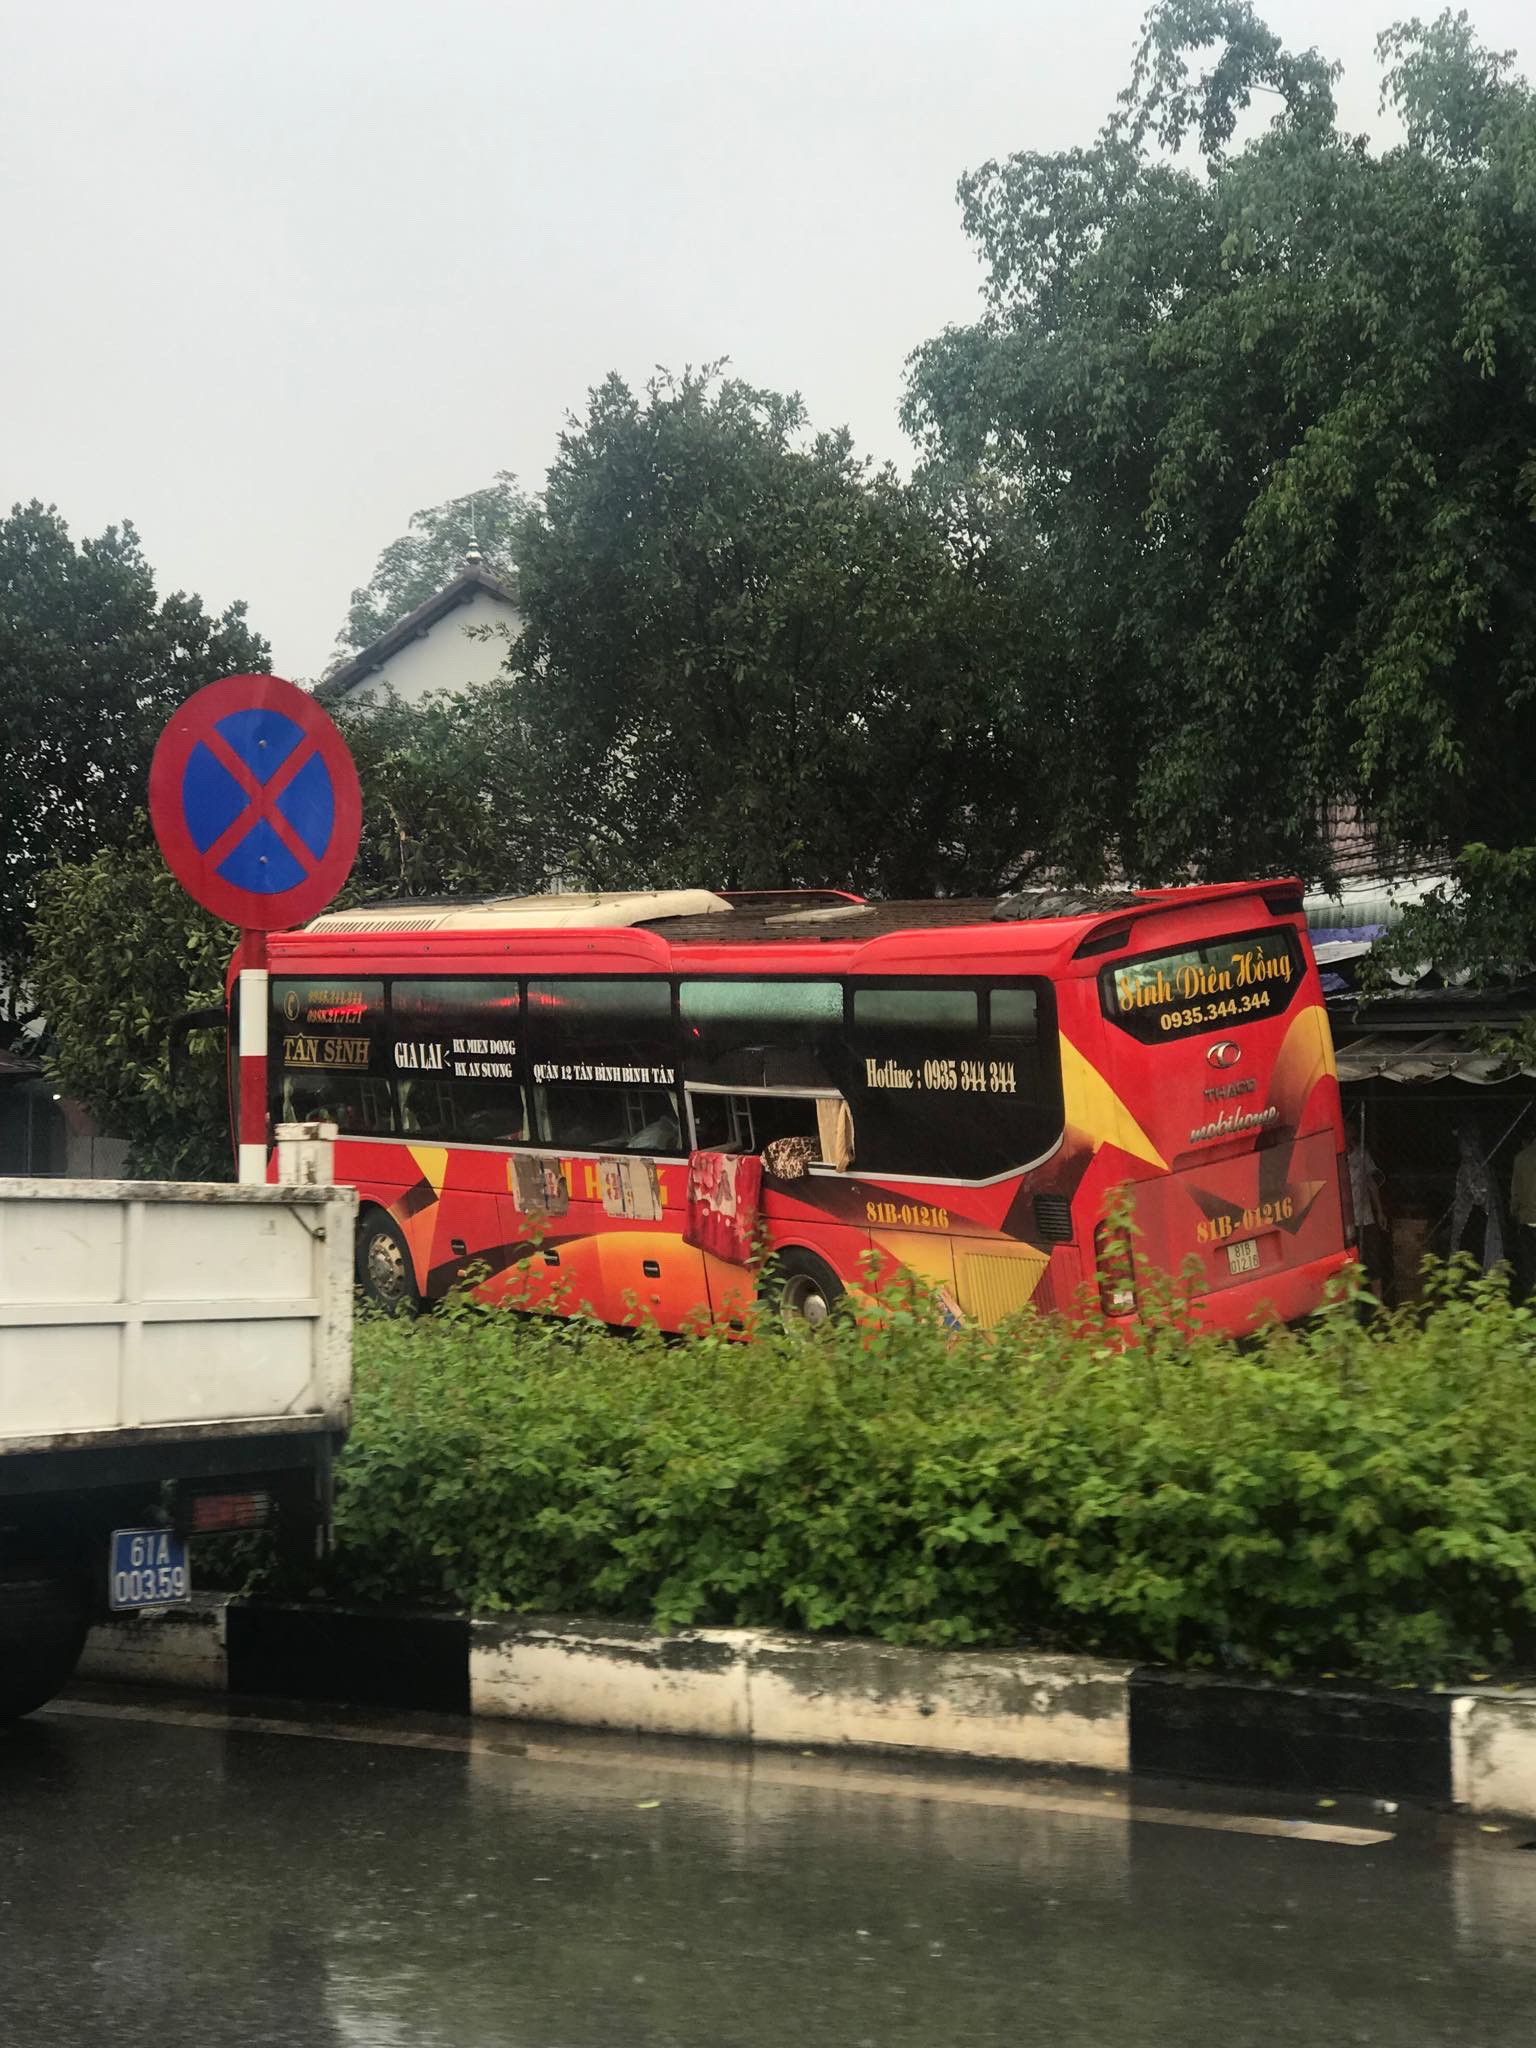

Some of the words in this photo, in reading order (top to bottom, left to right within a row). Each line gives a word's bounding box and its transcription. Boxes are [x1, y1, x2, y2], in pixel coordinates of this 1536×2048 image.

[1119, 971, 1174, 1011] Sinh
[1176, 966, 1233, 999] Diên
[1231, 946, 1293, 987] Hồng
[1160, 991, 1271, 1031] 0935.344.344
[283, 1033, 318, 1063] TÂN
[394, 1042, 418, 1068] GIA
[419, 1042, 443, 1070] LAI
[490, 1040, 516, 1055] DONG
[468, 1062, 480, 1077] AN
[533, 1061, 559, 1083] QUẬN
[561, 1066, 573, 1080] 12
[573, 1062, 593, 1081] TÂN
[594, 1062, 621, 1082] BÌNH
[622, 1063, 650, 1083] BÌNH
[652, 1064, 675, 1084] TÂN
[865, 1058, 914, 1089] Hotline
[924, 1059, 958, 1091] 0935
[960, 1061, 987, 1092] 344
[989, 1062, 1017, 1093] 344
[1189, 1106, 1279, 1143] mobihome
[866, 1202, 949, 1229] 81B-01216
[1196, 1196, 1293, 1243] 81B-01216
[1235, 1243, 1251, 1257] 81B
[131, 1534, 170, 1567] 61A
